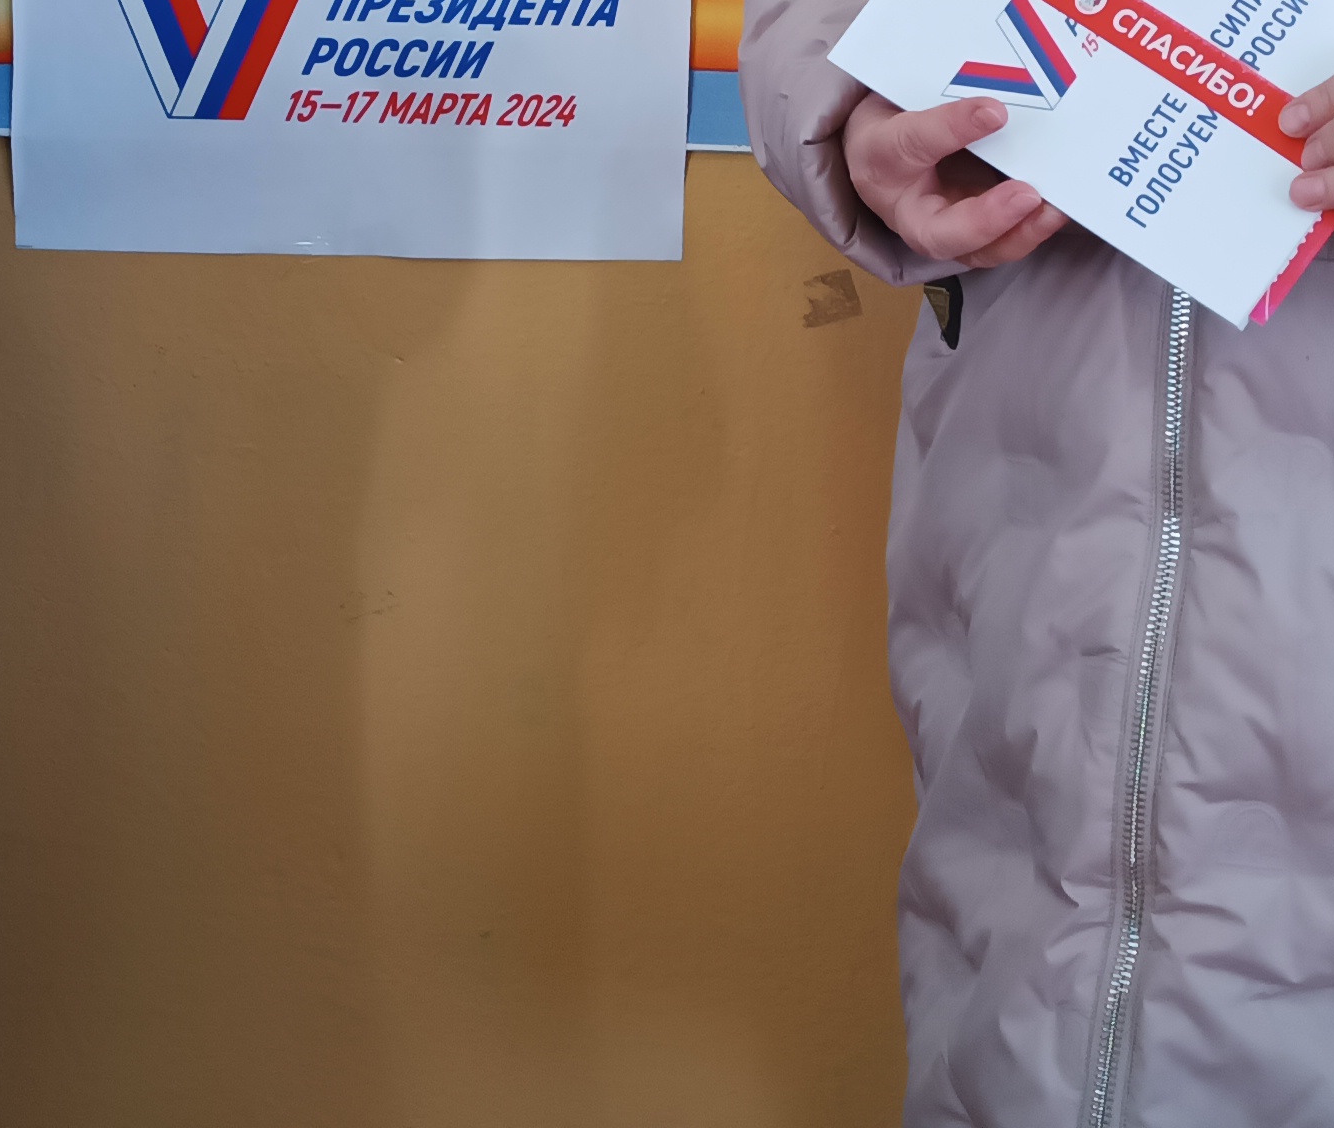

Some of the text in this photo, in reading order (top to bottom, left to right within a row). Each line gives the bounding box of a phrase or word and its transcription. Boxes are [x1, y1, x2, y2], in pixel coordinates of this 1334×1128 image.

[301, 37, 495, 79] РОССИИ
[1112, 8, 1266, 117] СПАСИБО!
[378, 91, 493, 126] МАРТА
[496, 93, 578, 128] 2024
[1108, 92, 1188, 187] ВМЕСТЕ
[1125, 107, 1219, 228] ГОЛОСУЕМ
